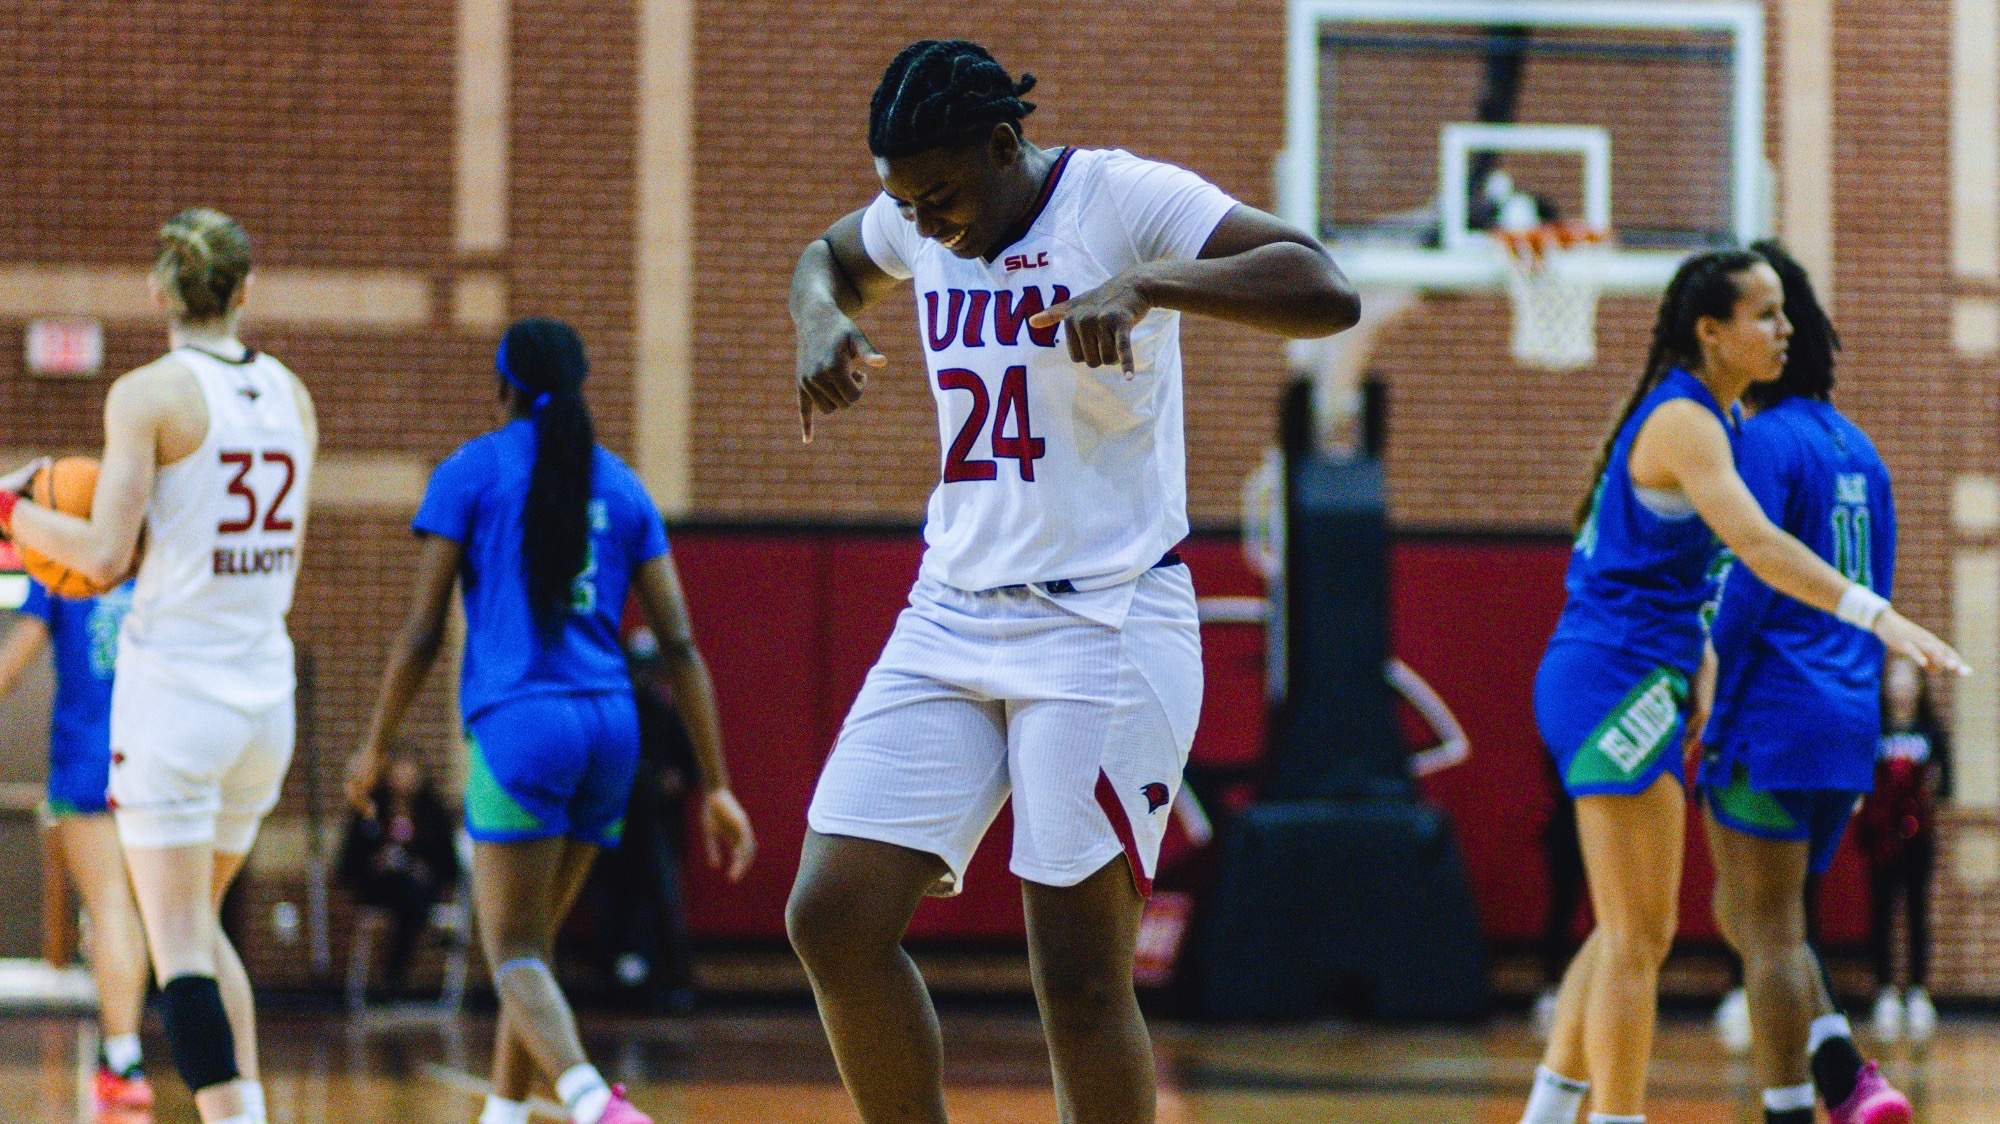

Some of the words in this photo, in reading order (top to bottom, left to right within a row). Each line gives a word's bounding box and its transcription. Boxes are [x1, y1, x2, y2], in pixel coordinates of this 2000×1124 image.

[1004, 251, 1049, 271] SLC
[925, 284, 1070, 351] UIW
[937, 365, 1046, 484] 24
[217, 450, 295, 534] 32
[212, 547, 294, 576] ELLIOTT
